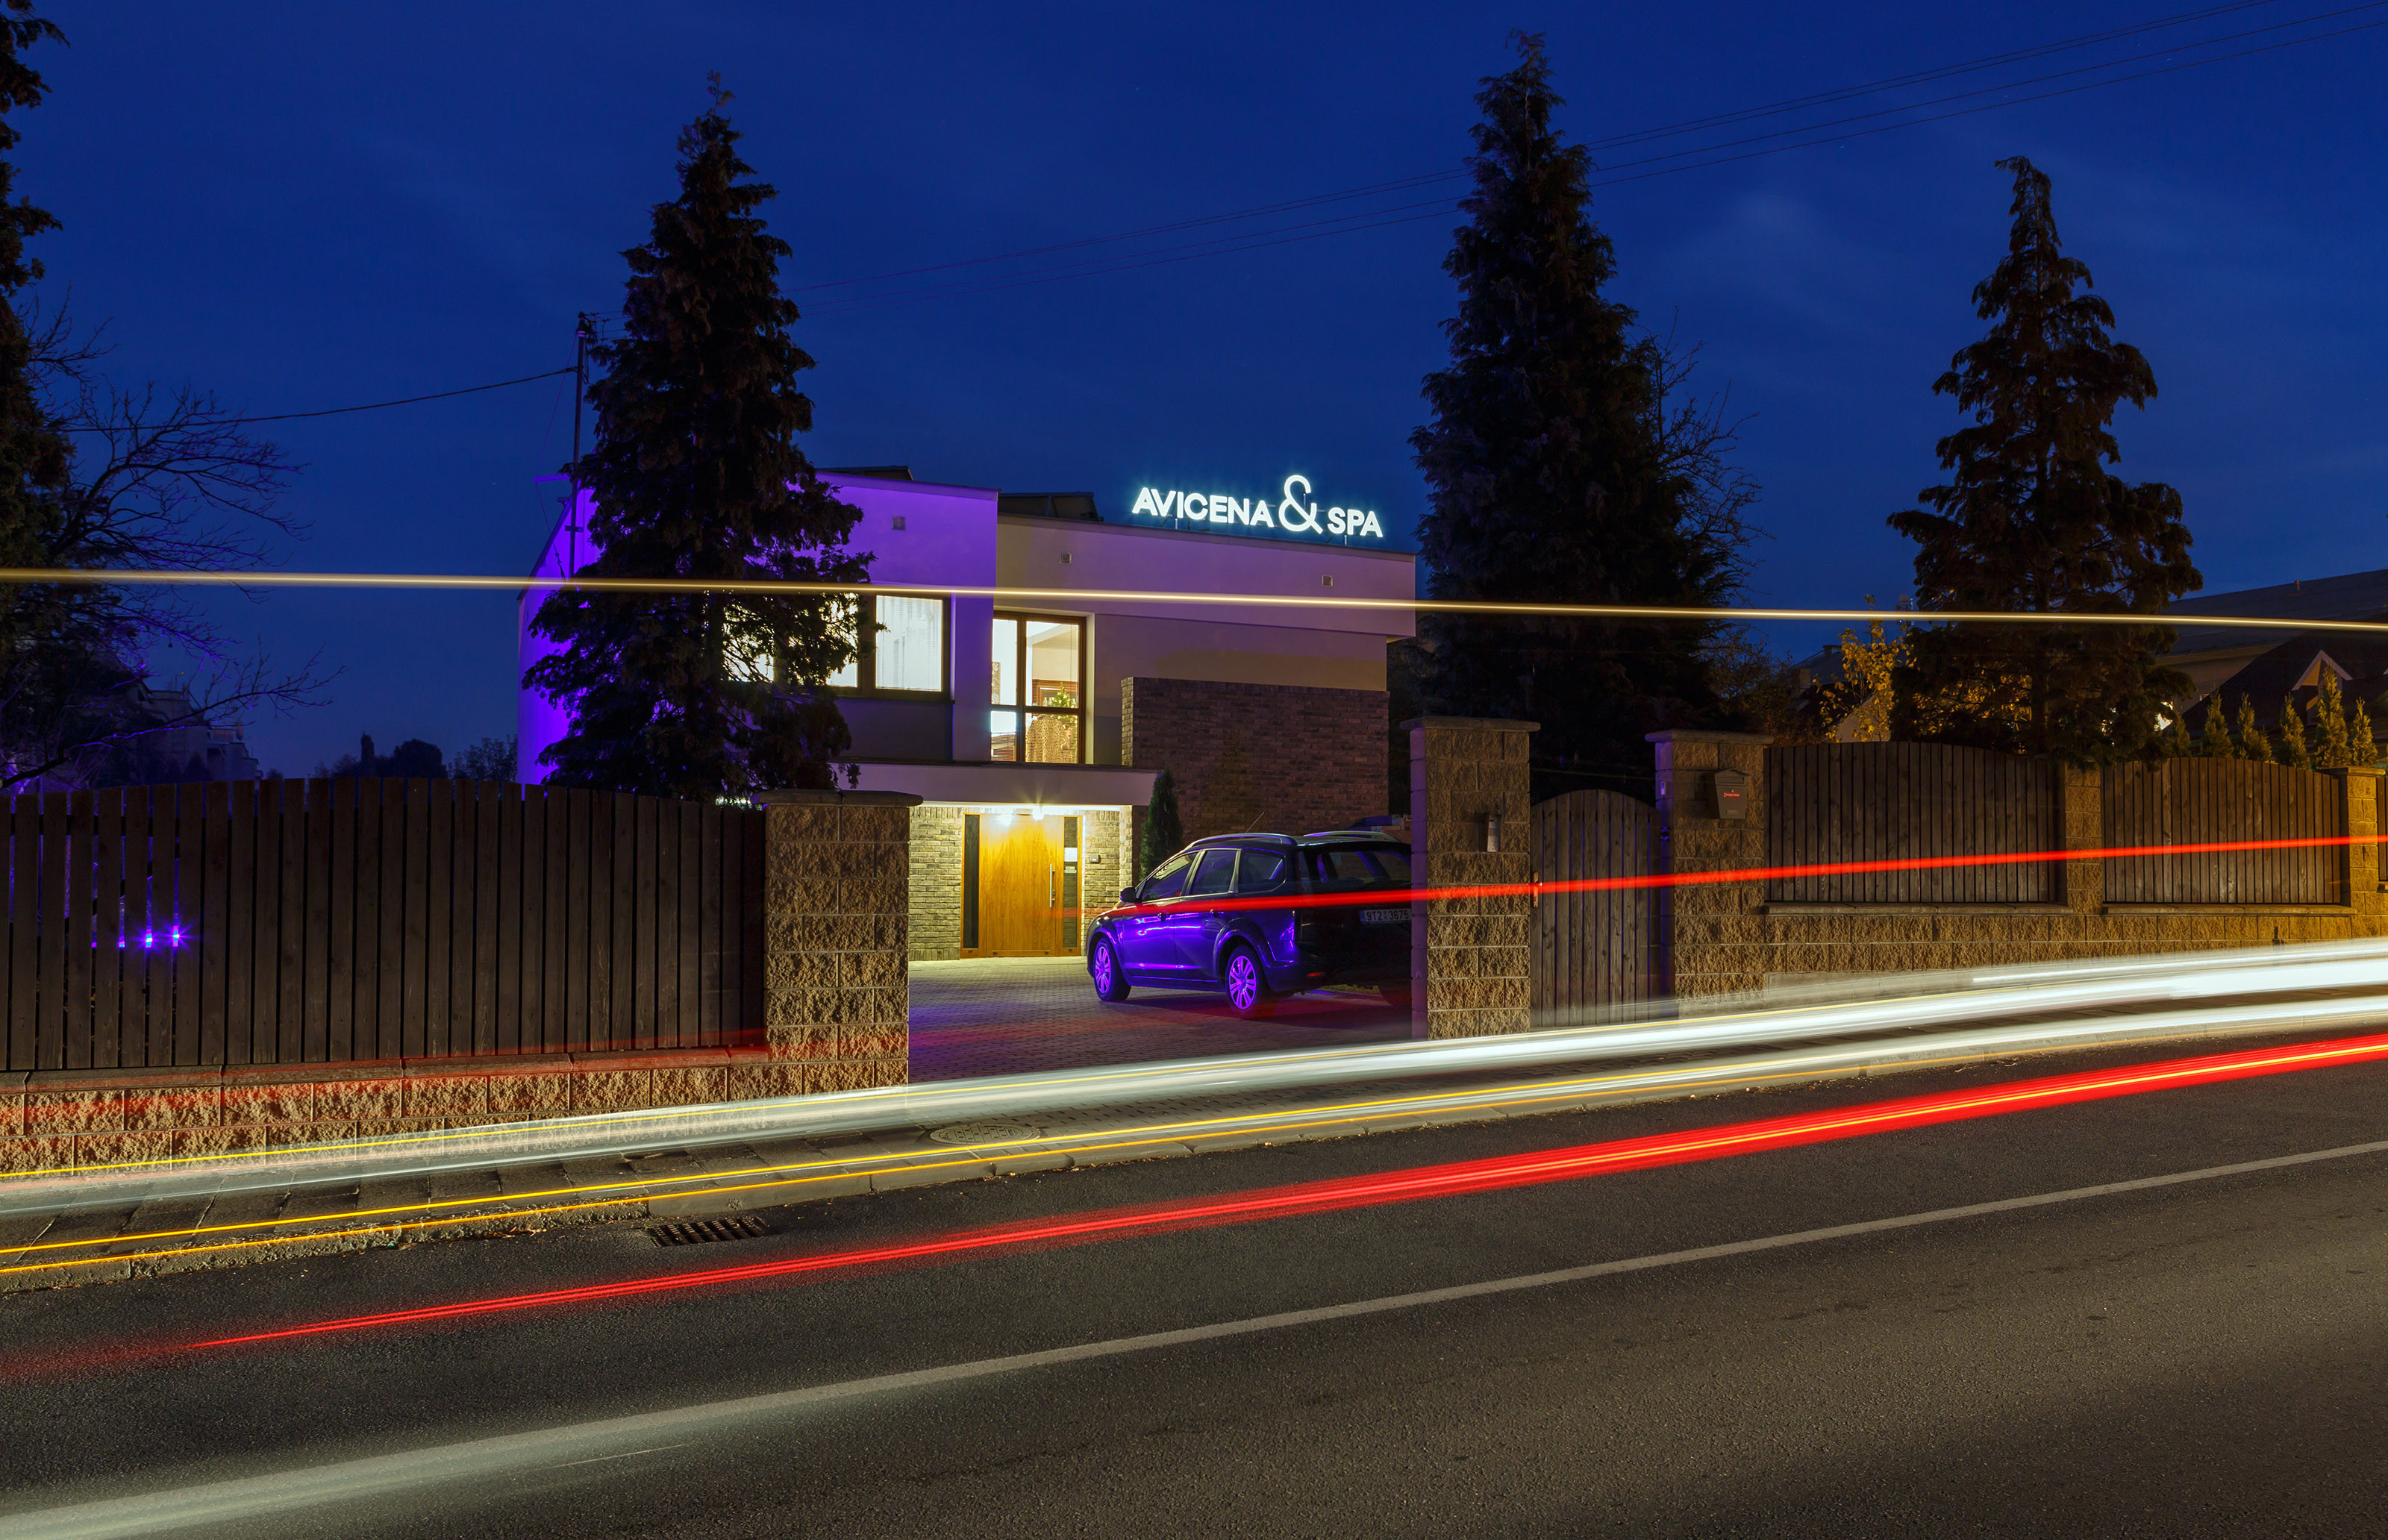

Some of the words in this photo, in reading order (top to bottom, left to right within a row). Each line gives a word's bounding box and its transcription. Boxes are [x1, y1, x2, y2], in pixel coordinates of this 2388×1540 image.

[1131, 486, 1275, 528] AVICENA
[1278, 475, 1323, 535] &
[1327, 507, 1384, 538] SPA
[1366, 911, 1383, 921] 9T2
[1389, 910, 1409, 920] 3675
